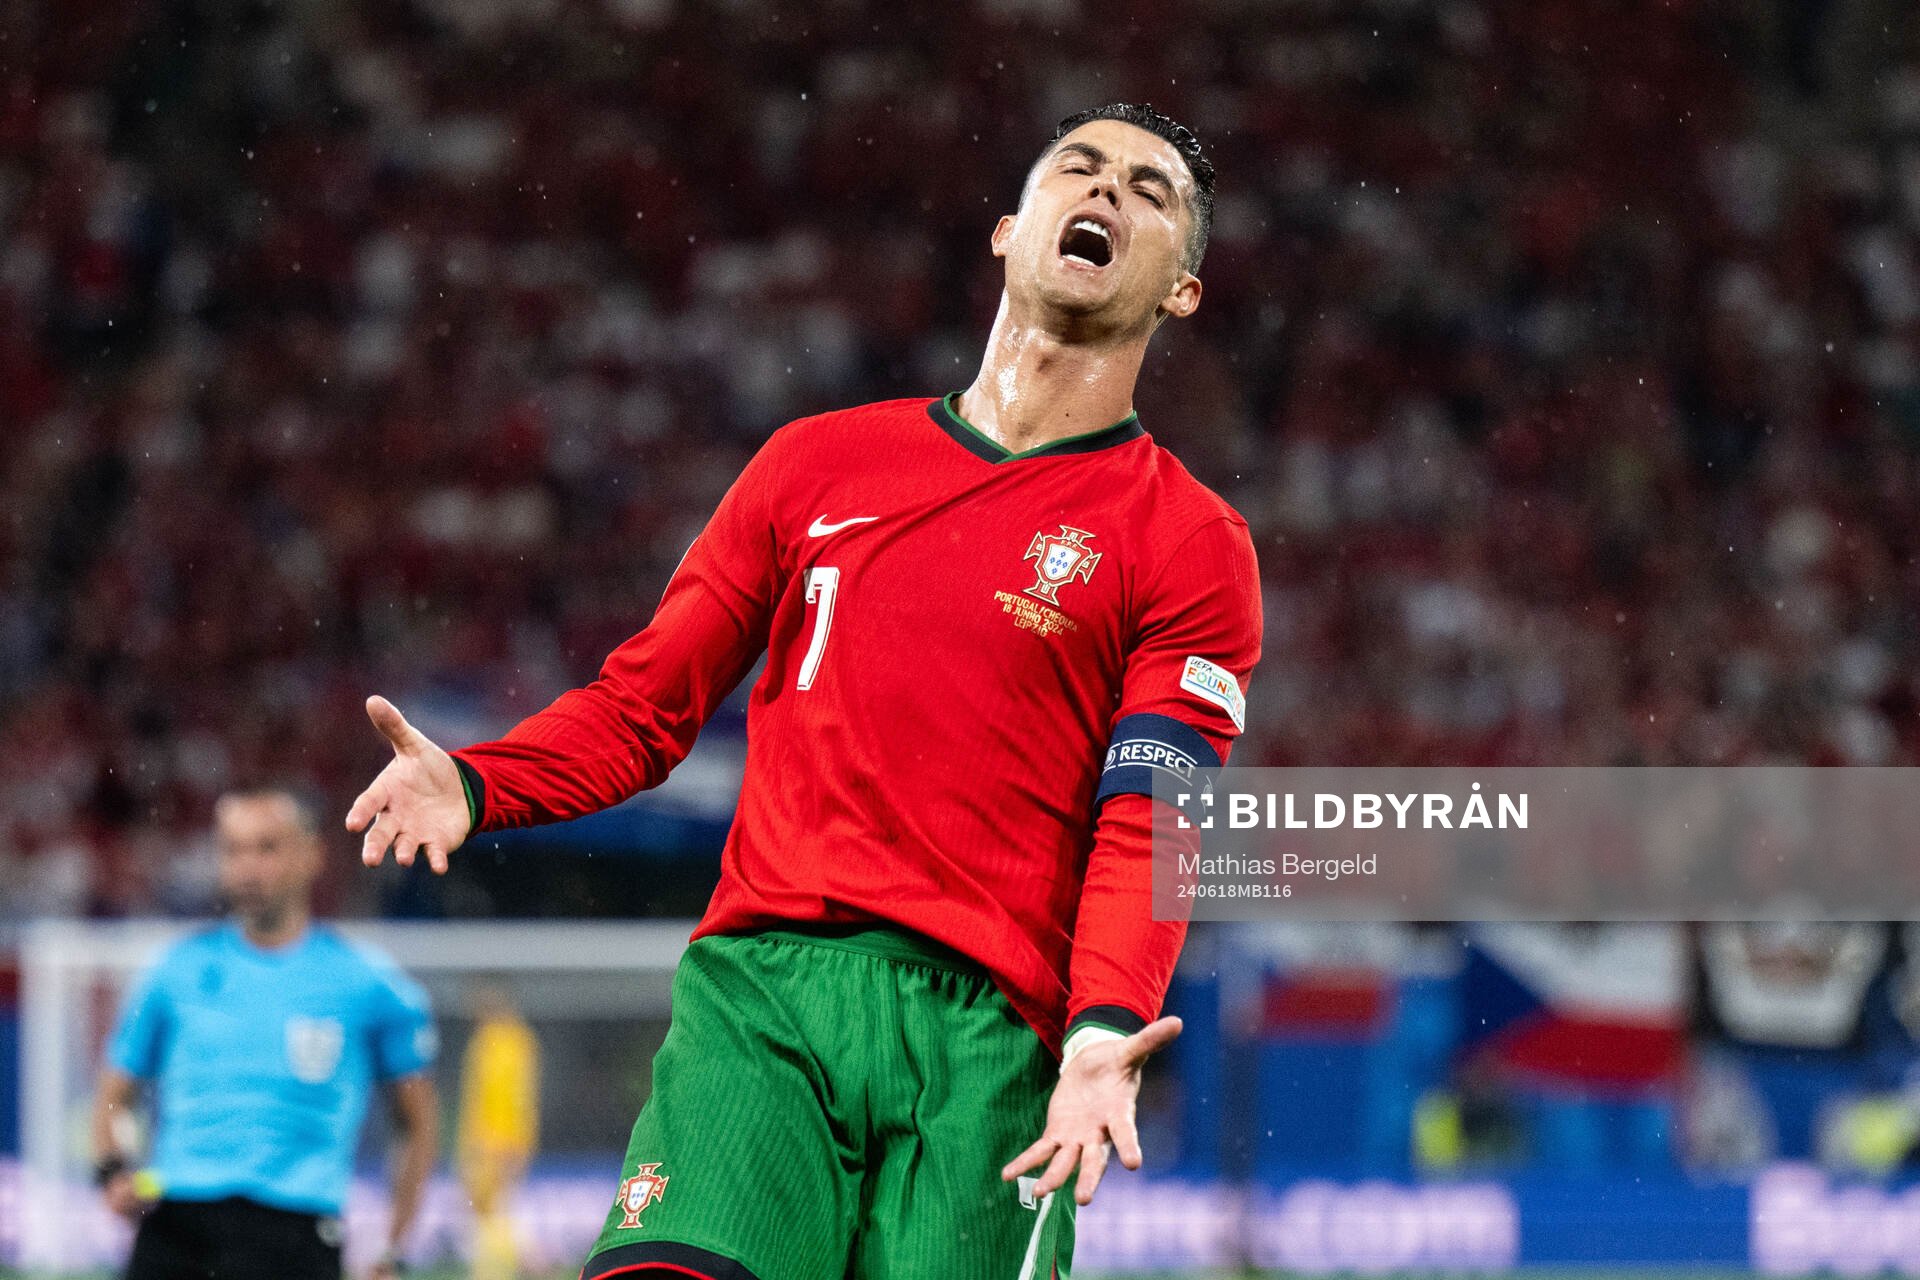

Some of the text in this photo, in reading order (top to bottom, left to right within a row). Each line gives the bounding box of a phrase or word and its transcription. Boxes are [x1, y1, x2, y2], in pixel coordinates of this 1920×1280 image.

[1003, 604, 1013, 613] 18
[1013, 607, 1041, 624] JUNHO
[797, 567, 840, 691] 7
[1014, 617, 1048, 637] LEIPZIG
[1191, 659, 1212, 673] UEFA
[1119, 744, 1196, 779] RESPECT
